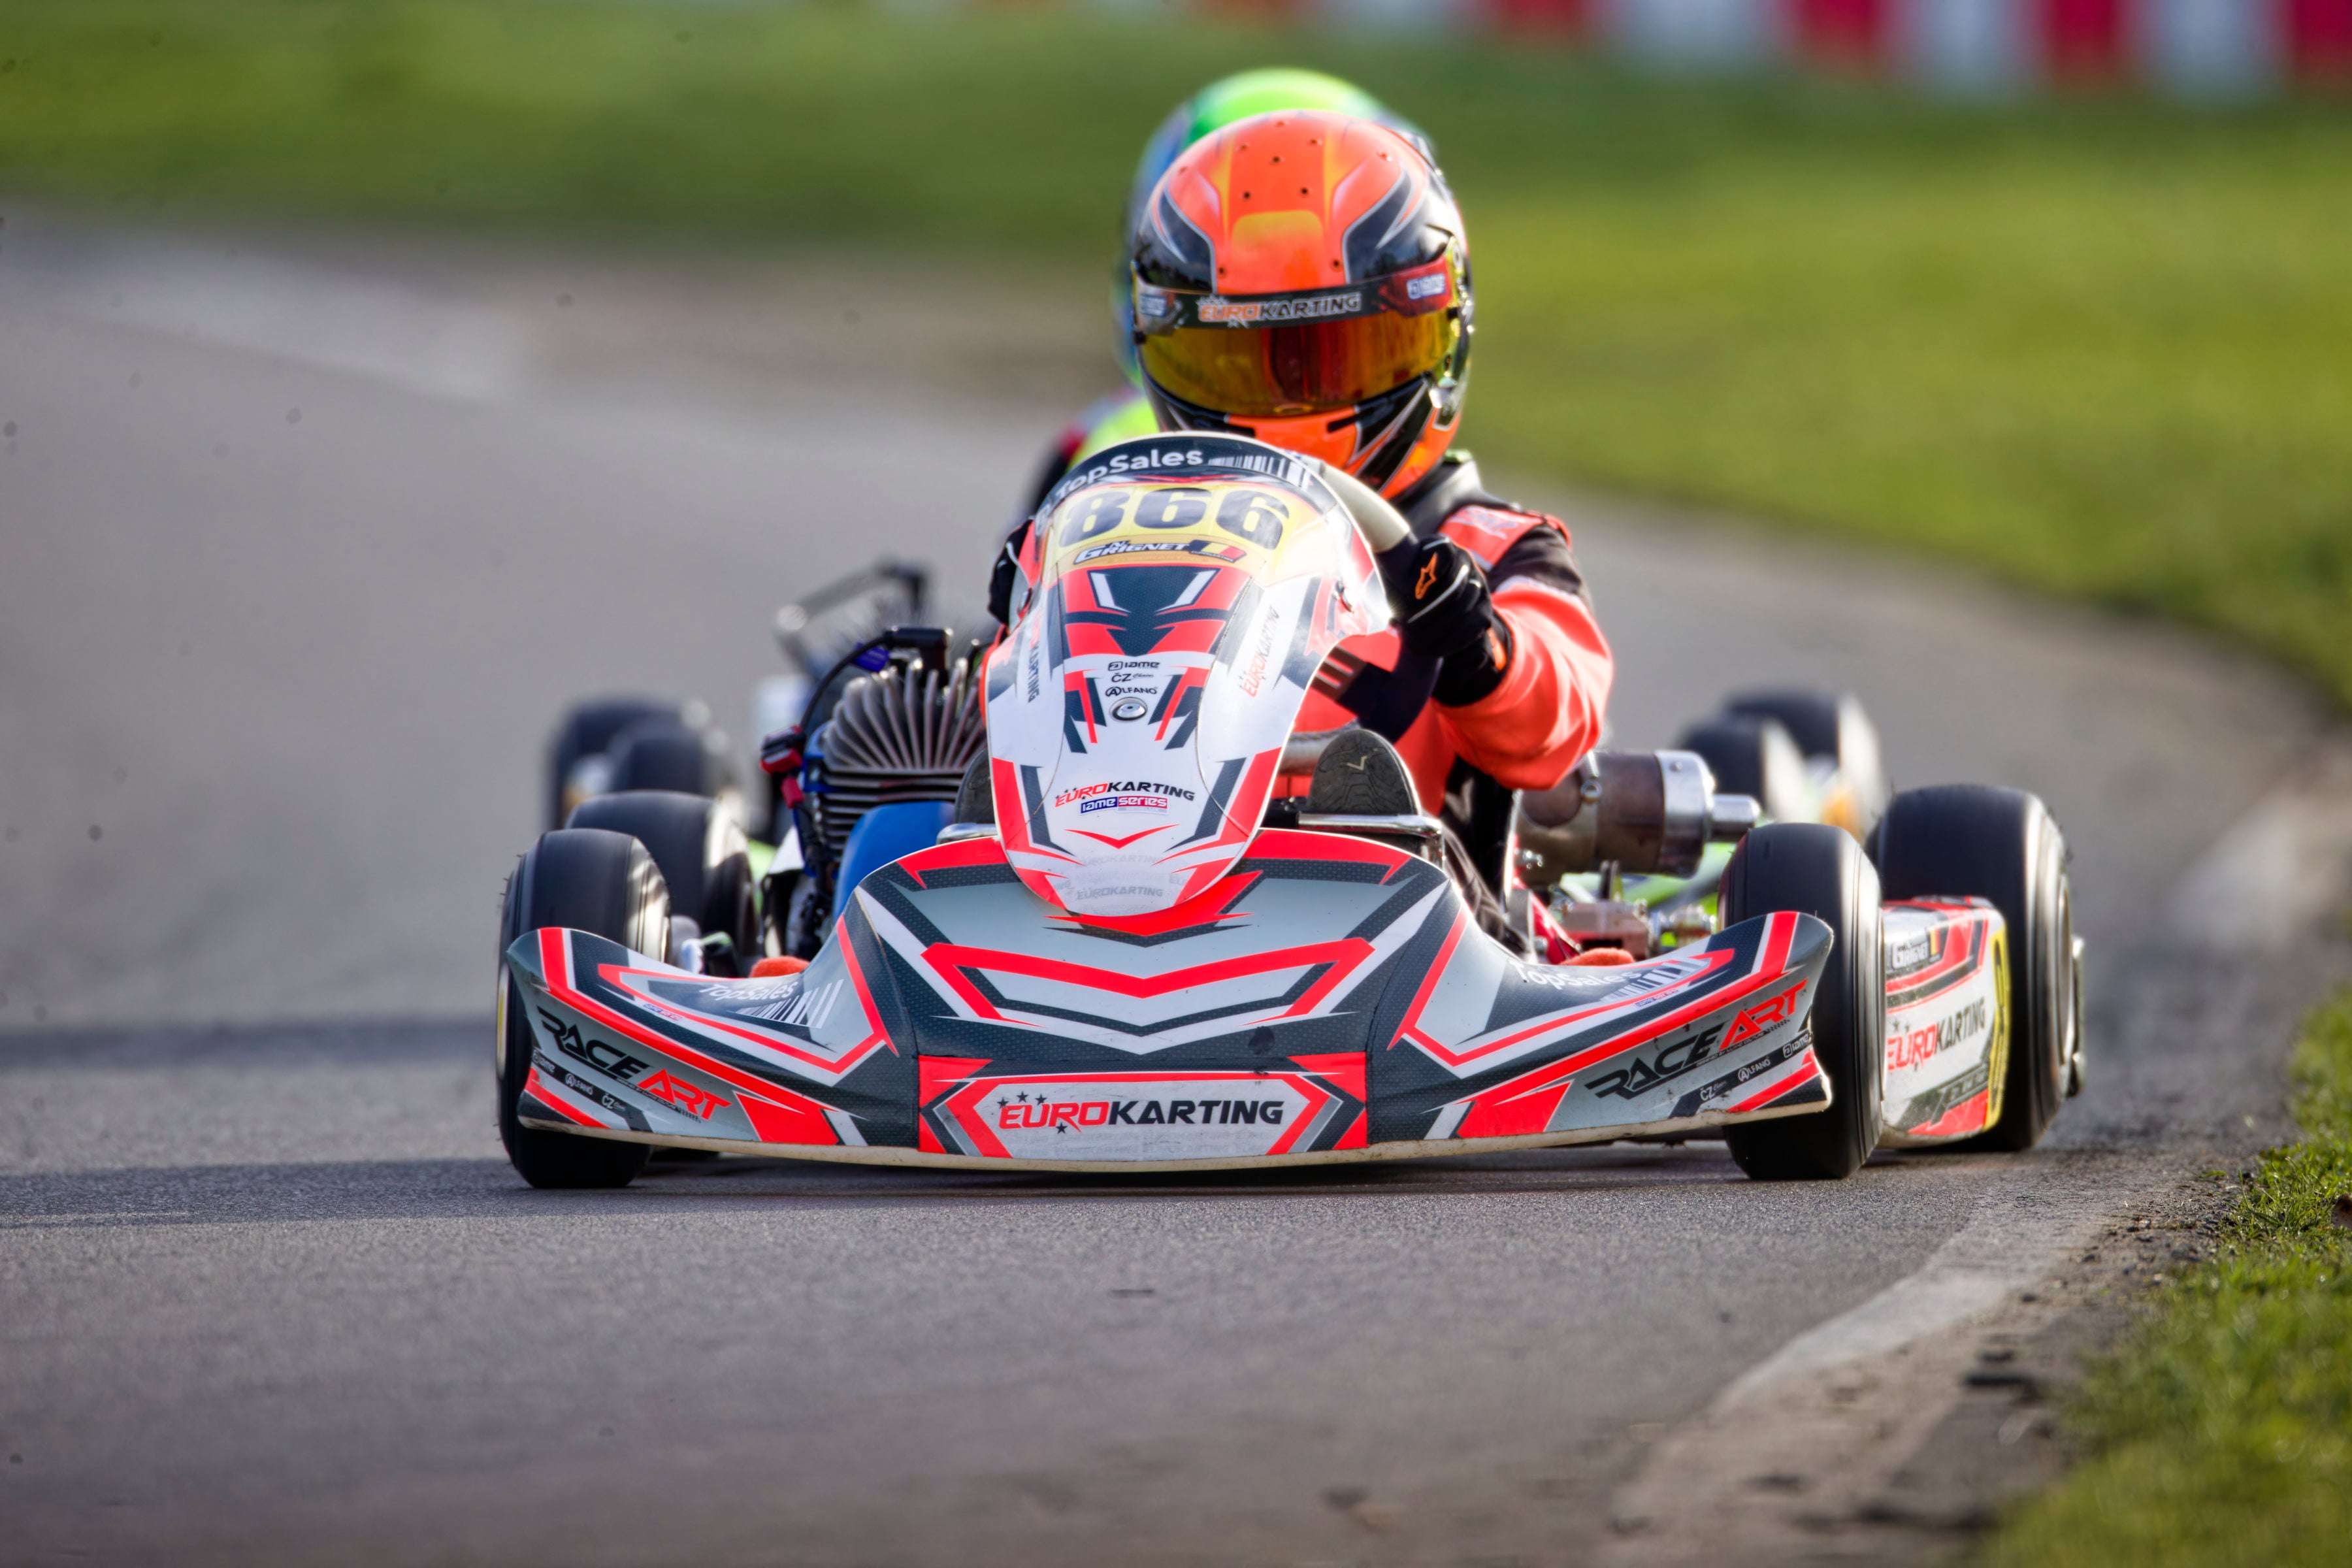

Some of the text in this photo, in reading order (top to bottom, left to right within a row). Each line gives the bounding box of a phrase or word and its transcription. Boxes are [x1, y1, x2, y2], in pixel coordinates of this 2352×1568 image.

[1198, 292, 1361, 327] EUROKARTING
[1059, 487, 1289, 550] 866
[1074, 543, 1189, 564] GRIGNET
[1105, 687, 1158, 696] ALFANO
[1055, 781, 1196, 808] EUROKARTING
[1119, 797, 1168, 807] series
[1887, 996, 1985, 1071] EUROKARTING
[1738, 1058, 1771, 1082] ALFANO
[998, 1100, 1284, 1132] EUROKARTING
